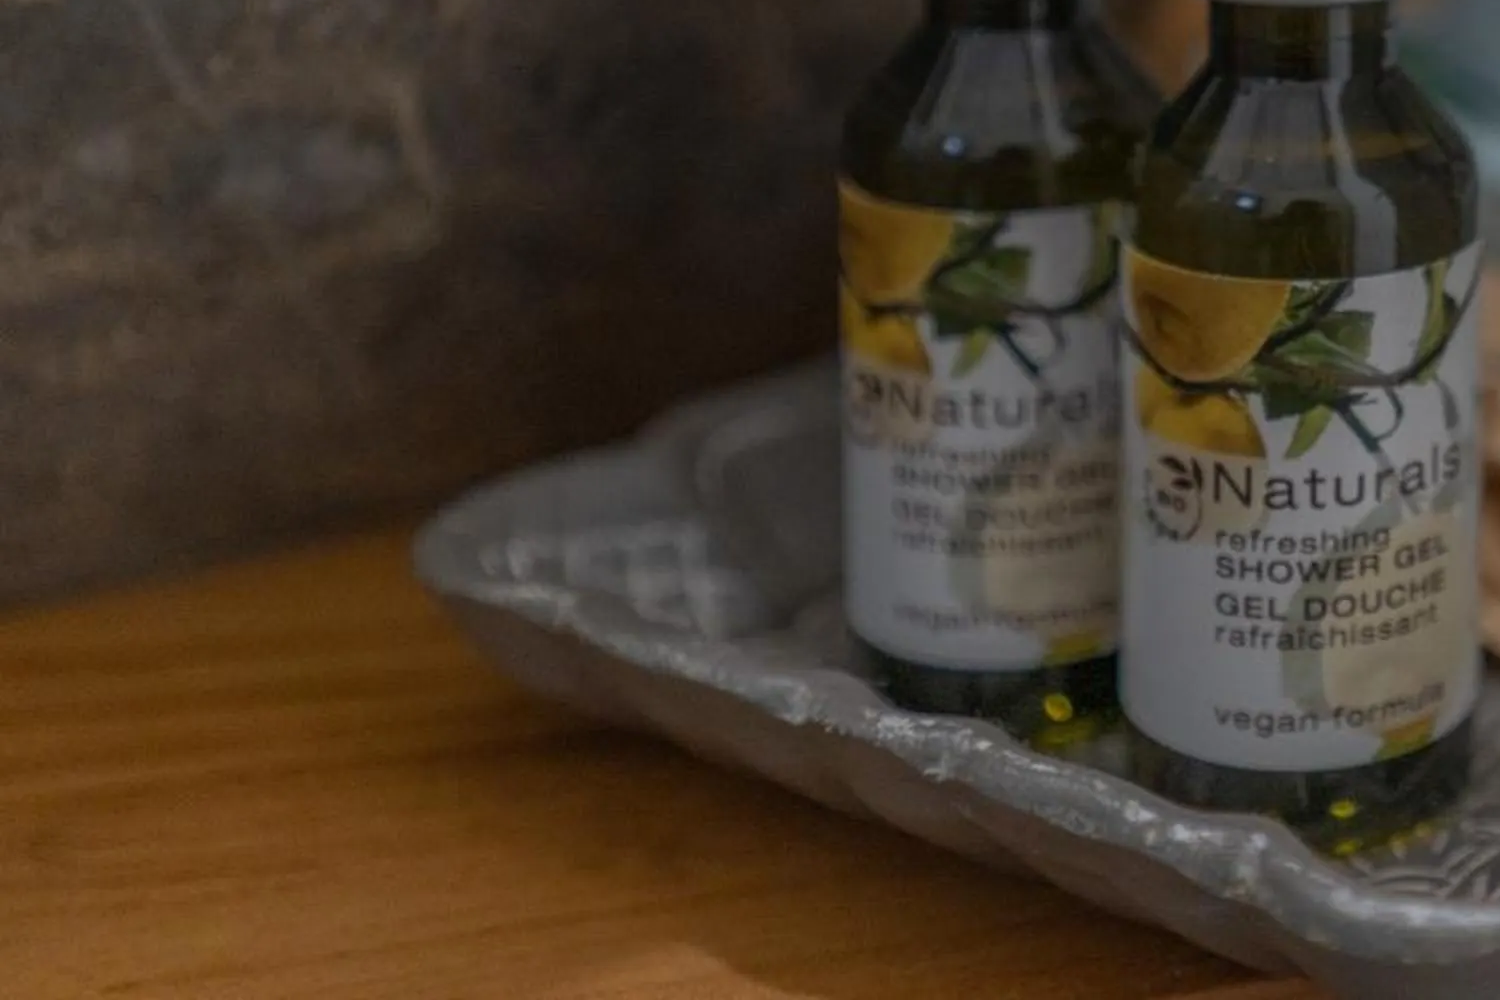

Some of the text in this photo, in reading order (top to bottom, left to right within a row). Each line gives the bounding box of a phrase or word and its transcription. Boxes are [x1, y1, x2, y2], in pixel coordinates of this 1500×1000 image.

[1212, 442, 1462, 511] Naturals
[1214, 526, 1391, 555] refreshing
[1214, 533, 1449, 585] SHOWER GEL
[1214, 567, 1447, 622] GEL DOUCHE
[1213, 705, 1320, 739] vegan
